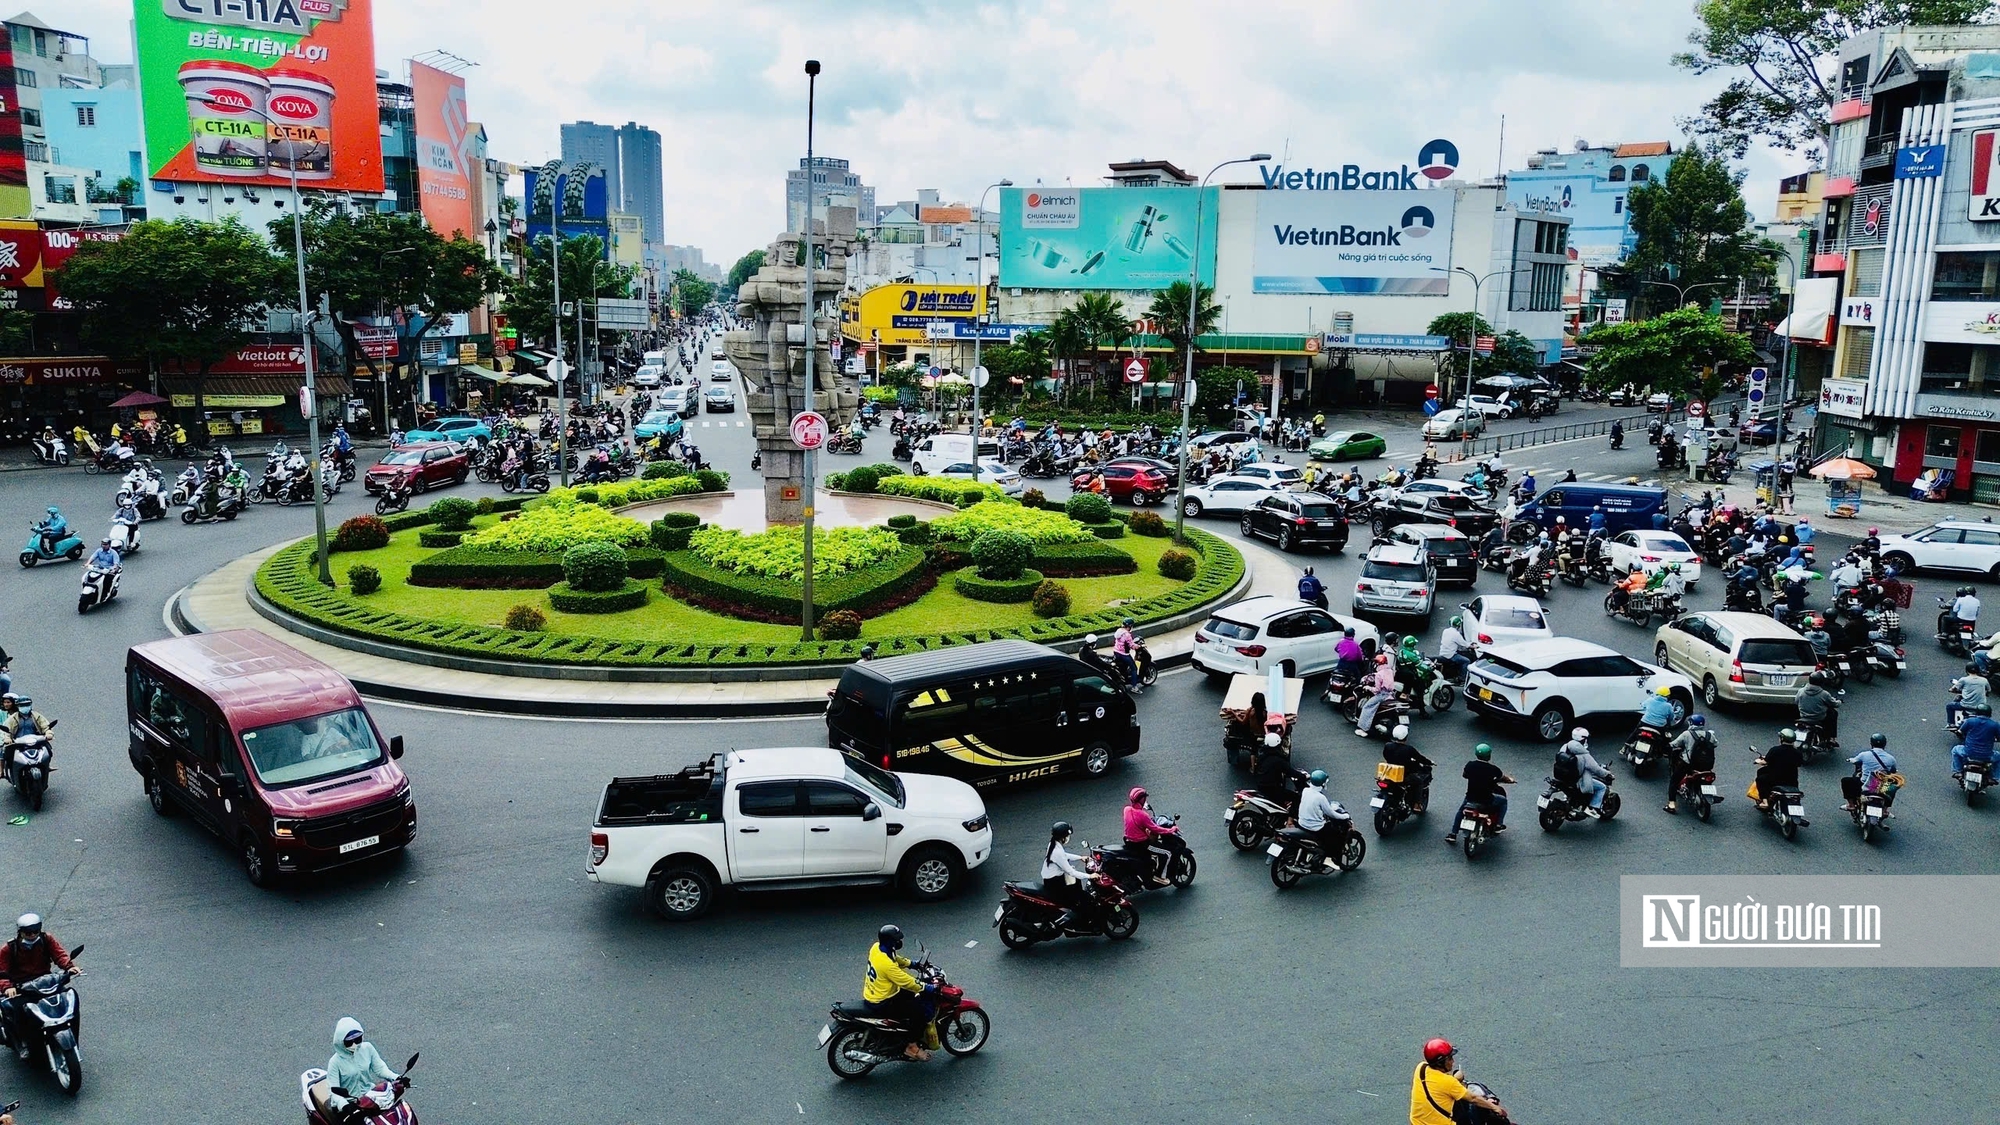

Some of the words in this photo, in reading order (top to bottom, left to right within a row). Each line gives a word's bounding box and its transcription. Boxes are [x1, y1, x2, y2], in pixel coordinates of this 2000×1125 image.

[302, 1, 330, 12] PLUS
[276, 101, 313, 115] KOVA
[204, 121, 253, 136] CT-11A
[273, 127, 319, 141] CT-11A
[431, 144, 446, 158] KIM
[1260, 165, 1418, 190] VietinBank
[1042, 195, 1076, 206] elmich
[1525, 193, 1562, 212] VietinBank
[1273, 225, 1402, 246] VietinBank
[1338, 252, 1361, 262] Nâng
[1363, 253, 1377, 262] giá
[1378, 253, 1387, 263] trị
[1388, 254, 1409, 263] cuộc
[1411, 251, 1432, 263] sống
[1326, 335, 1350, 343] Mobil
[236, 351, 286, 361] Vietlott
[43, 366, 101, 379] SUKIYA
[1956, 407, 1995, 419] Kentucky
[1008, 764, 1060, 783] HIACE
[976, 778, 998, 788] TOYOTA
